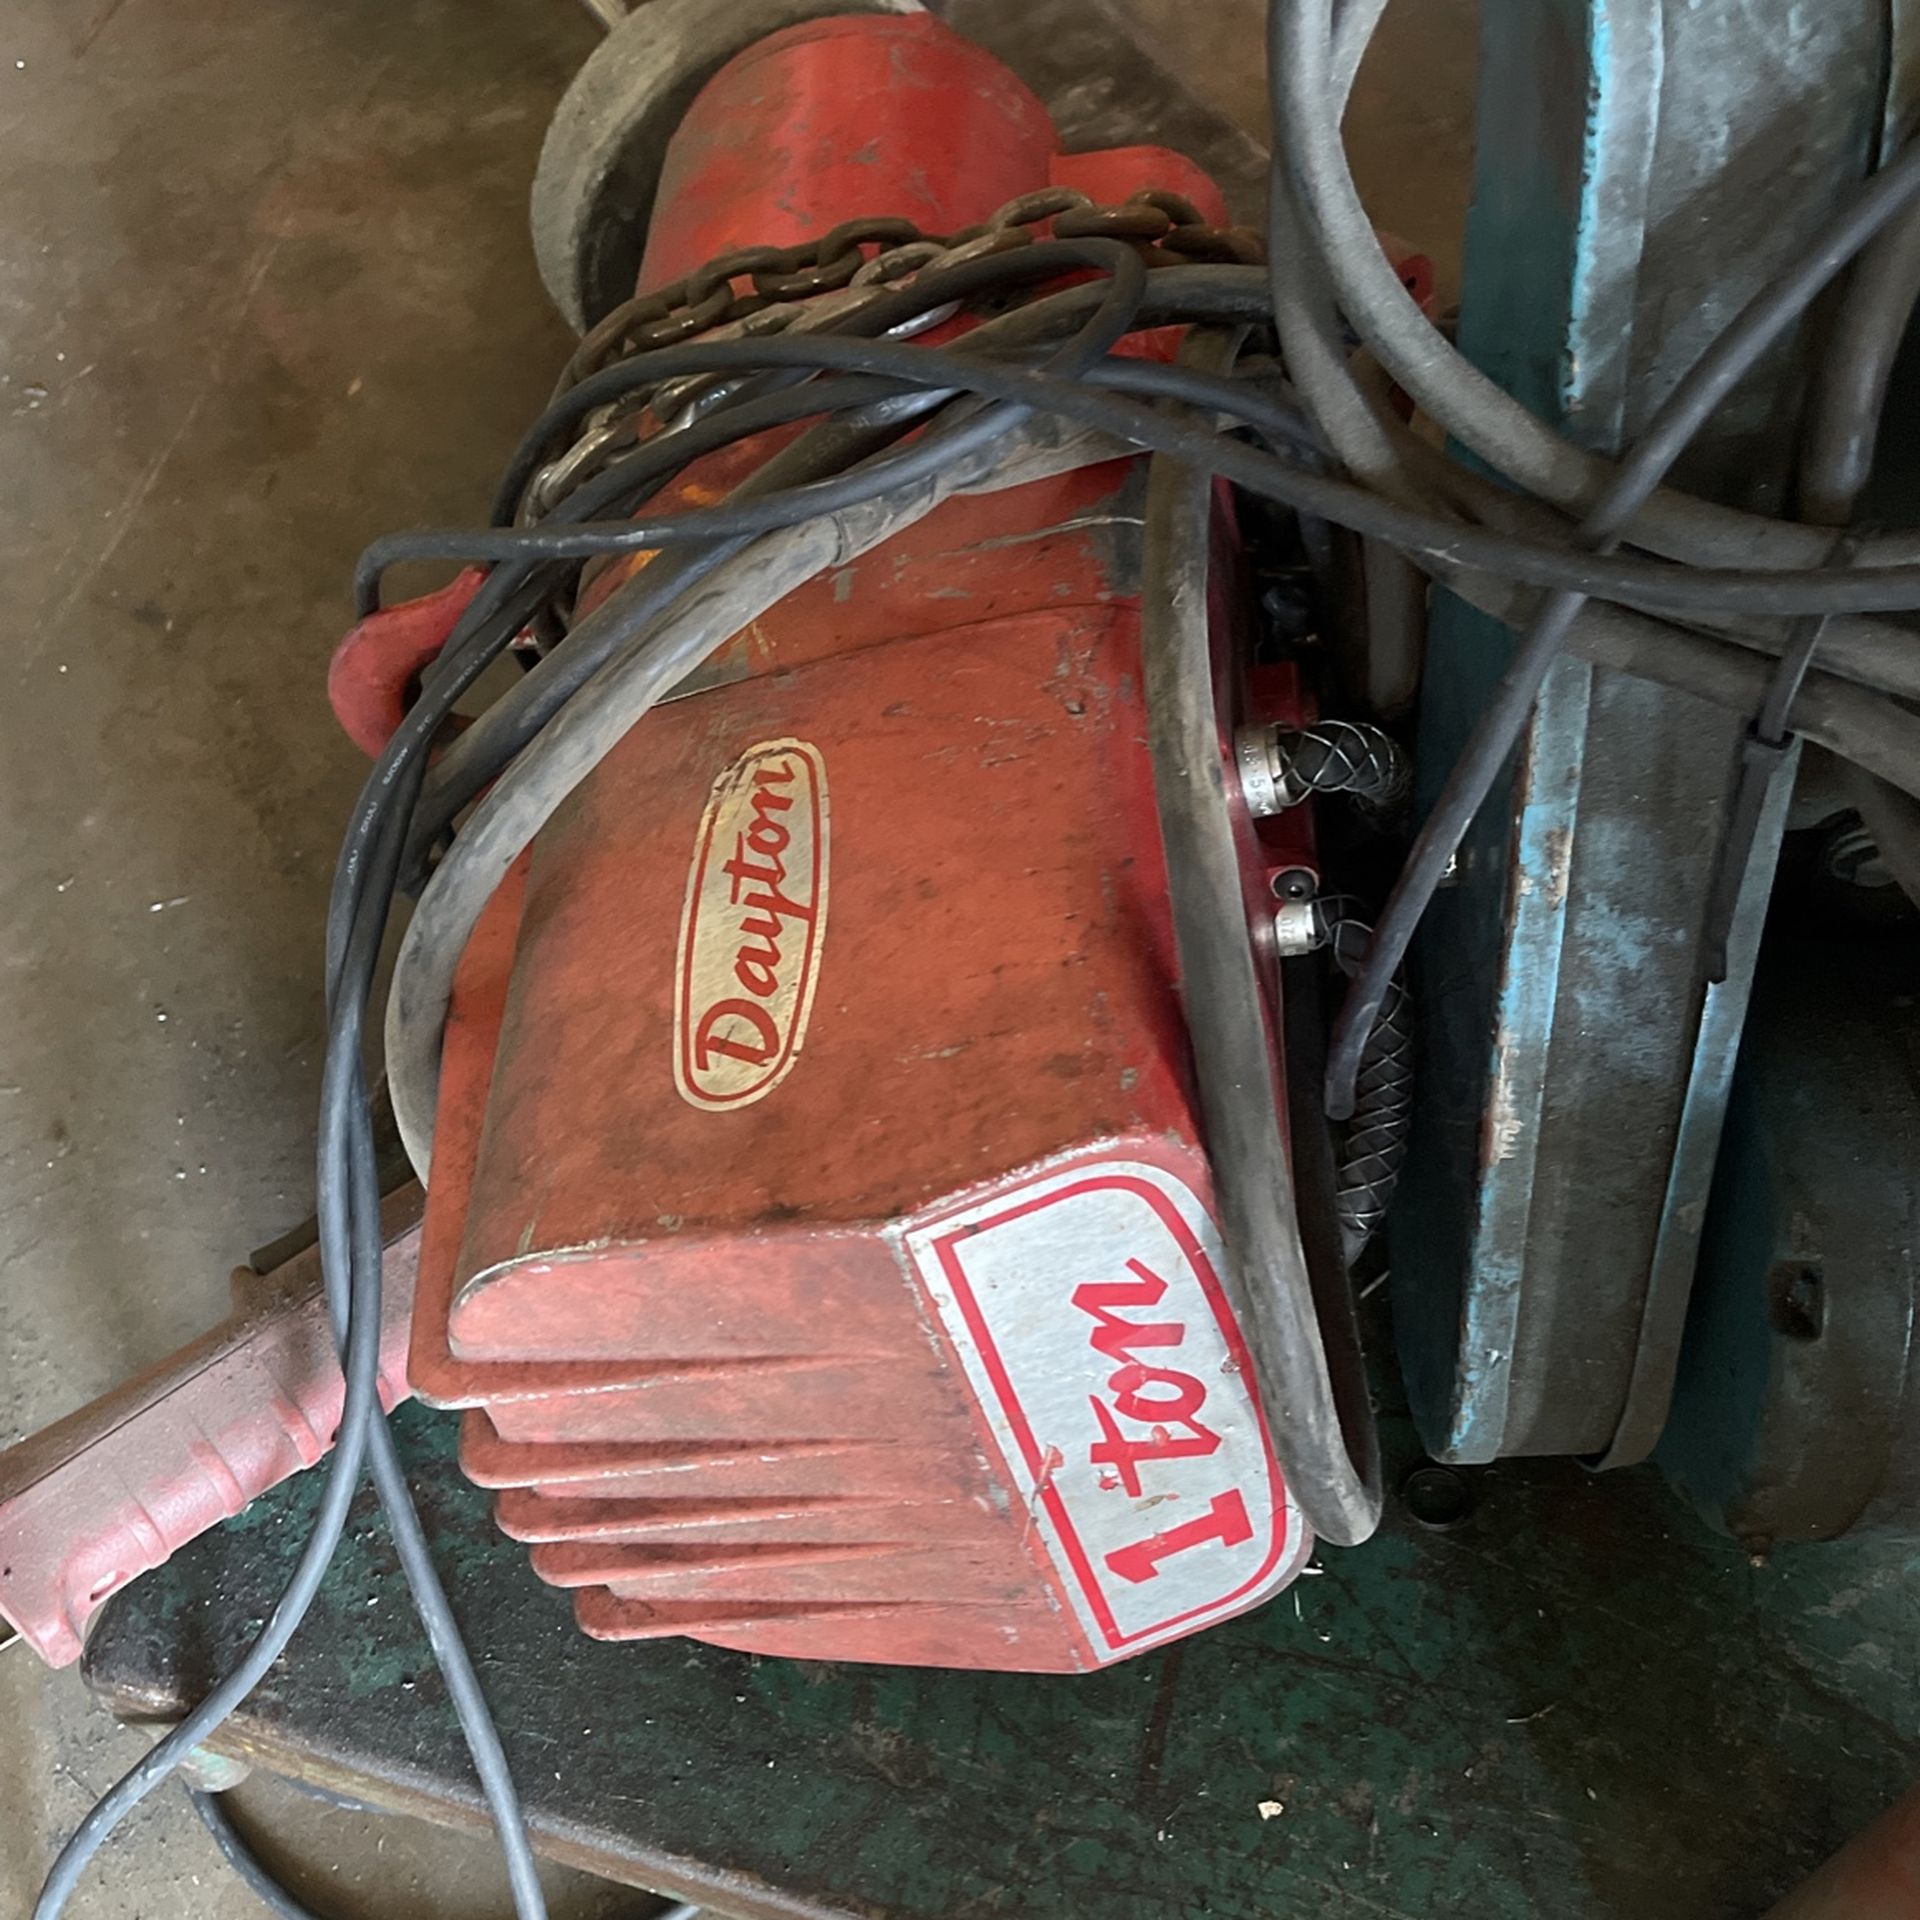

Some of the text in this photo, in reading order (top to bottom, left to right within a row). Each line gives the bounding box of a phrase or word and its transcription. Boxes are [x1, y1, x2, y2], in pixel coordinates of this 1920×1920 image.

[694, 759, 812, 1072] Dayton
[1070, 1257, 1254, 1584] 1 ton
